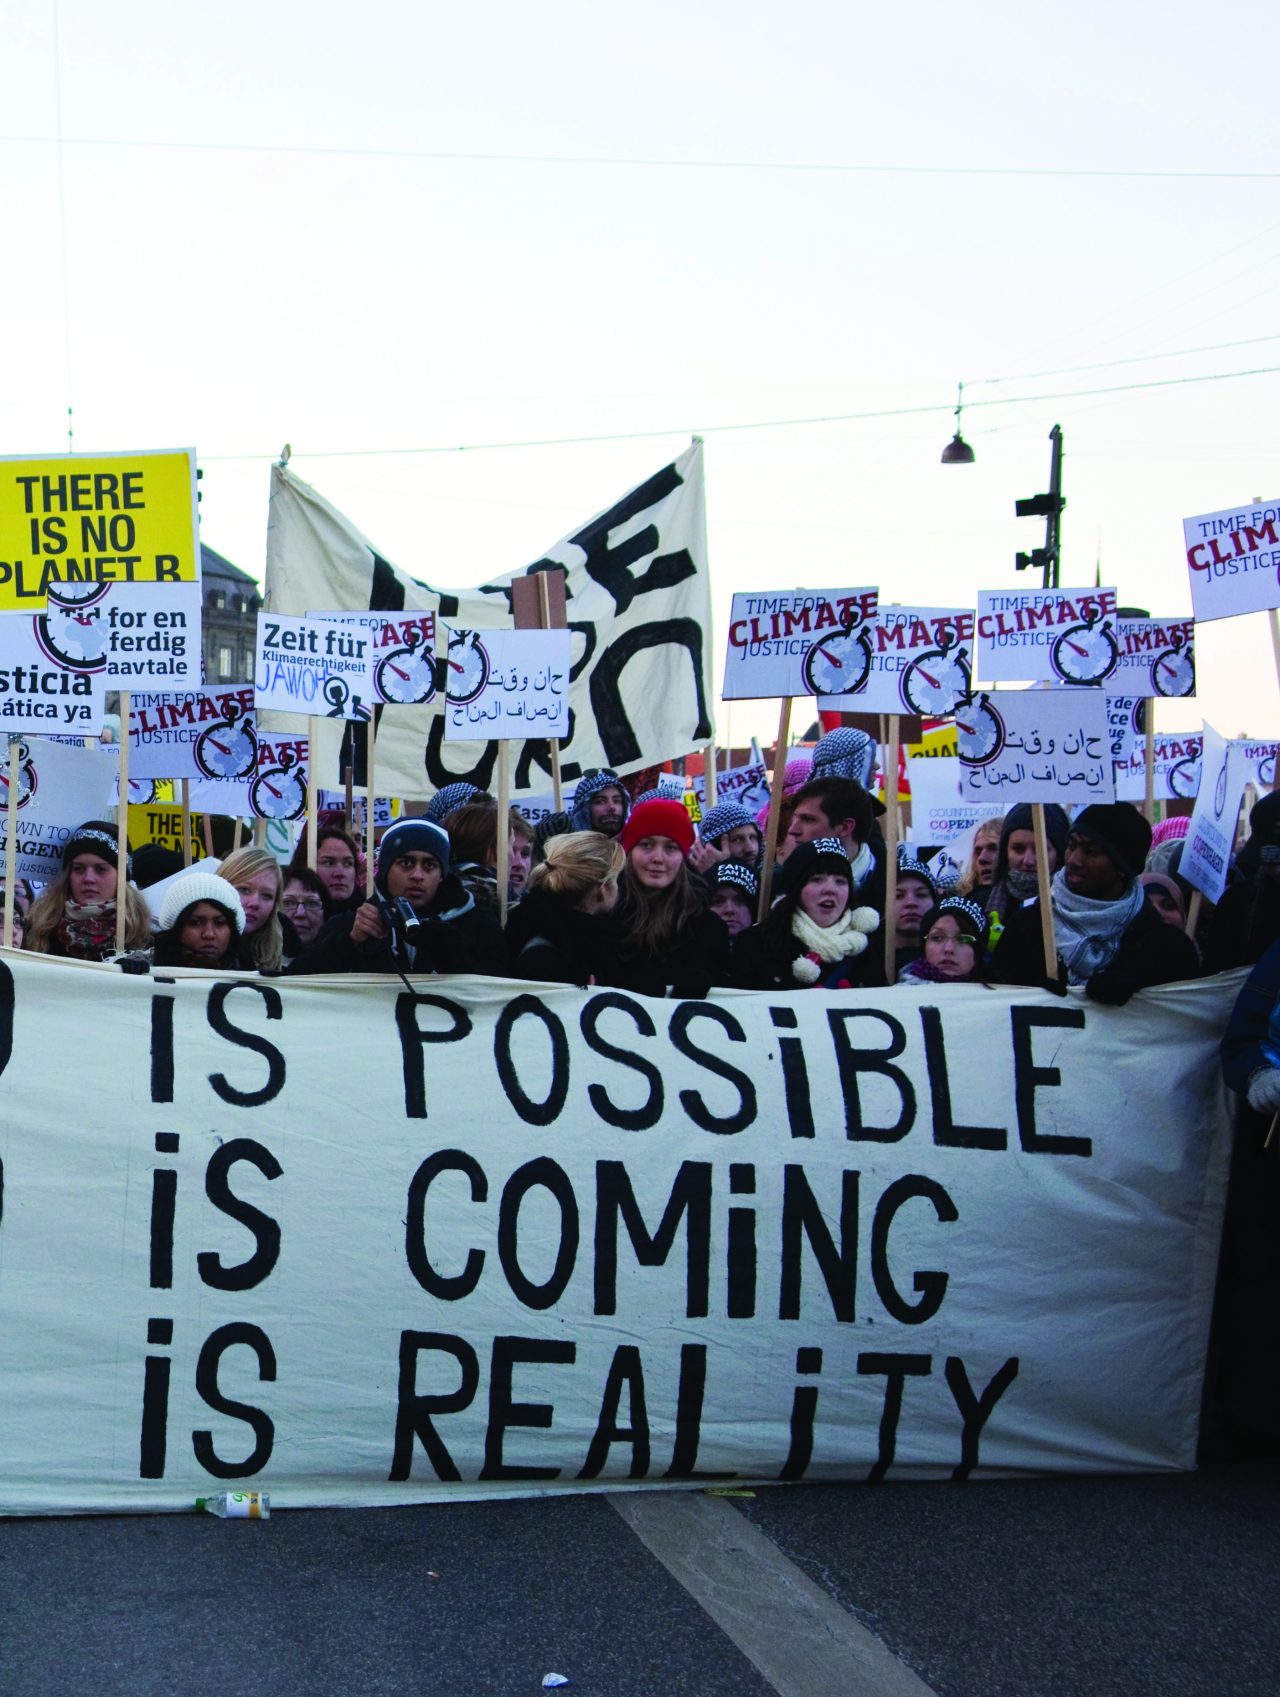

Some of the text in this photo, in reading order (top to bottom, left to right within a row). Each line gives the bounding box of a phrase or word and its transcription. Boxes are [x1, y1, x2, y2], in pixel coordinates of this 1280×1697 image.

[16, 471, 145, 513] THERE
[30, 514, 136, 556] IS NO
[1199, 514, 1246, 537] TIME
[746, 596, 826, 615] TIME FOR
[989, 595, 1065, 611] TIME FOR
[108, 606, 148, 628] for
[154, 610, 187, 629] en
[729, 591, 878, 648] CLIMATE
[885, 614, 919, 629] FOR
[978, 591, 1118, 639] CLIMATE
[264, 623, 367, 659] Zeit für
[871, 613, 974, 653] MATE
[991, 631, 1055, 650] JUSTICE
[741, 639, 811, 661] JUSTICE
[256, 661, 333, 702] JAWOHL
[130, 692, 206, 708] TIME FOR
[64, 704, 92, 724] ya
[135, 729, 198, 747] JUSTICE
[1125, 763, 1170, 778] JUSICE
[510, 804, 550, 820] asa
[47, 825, 70, 842] TO
[18, 862, 59, 876] justice
